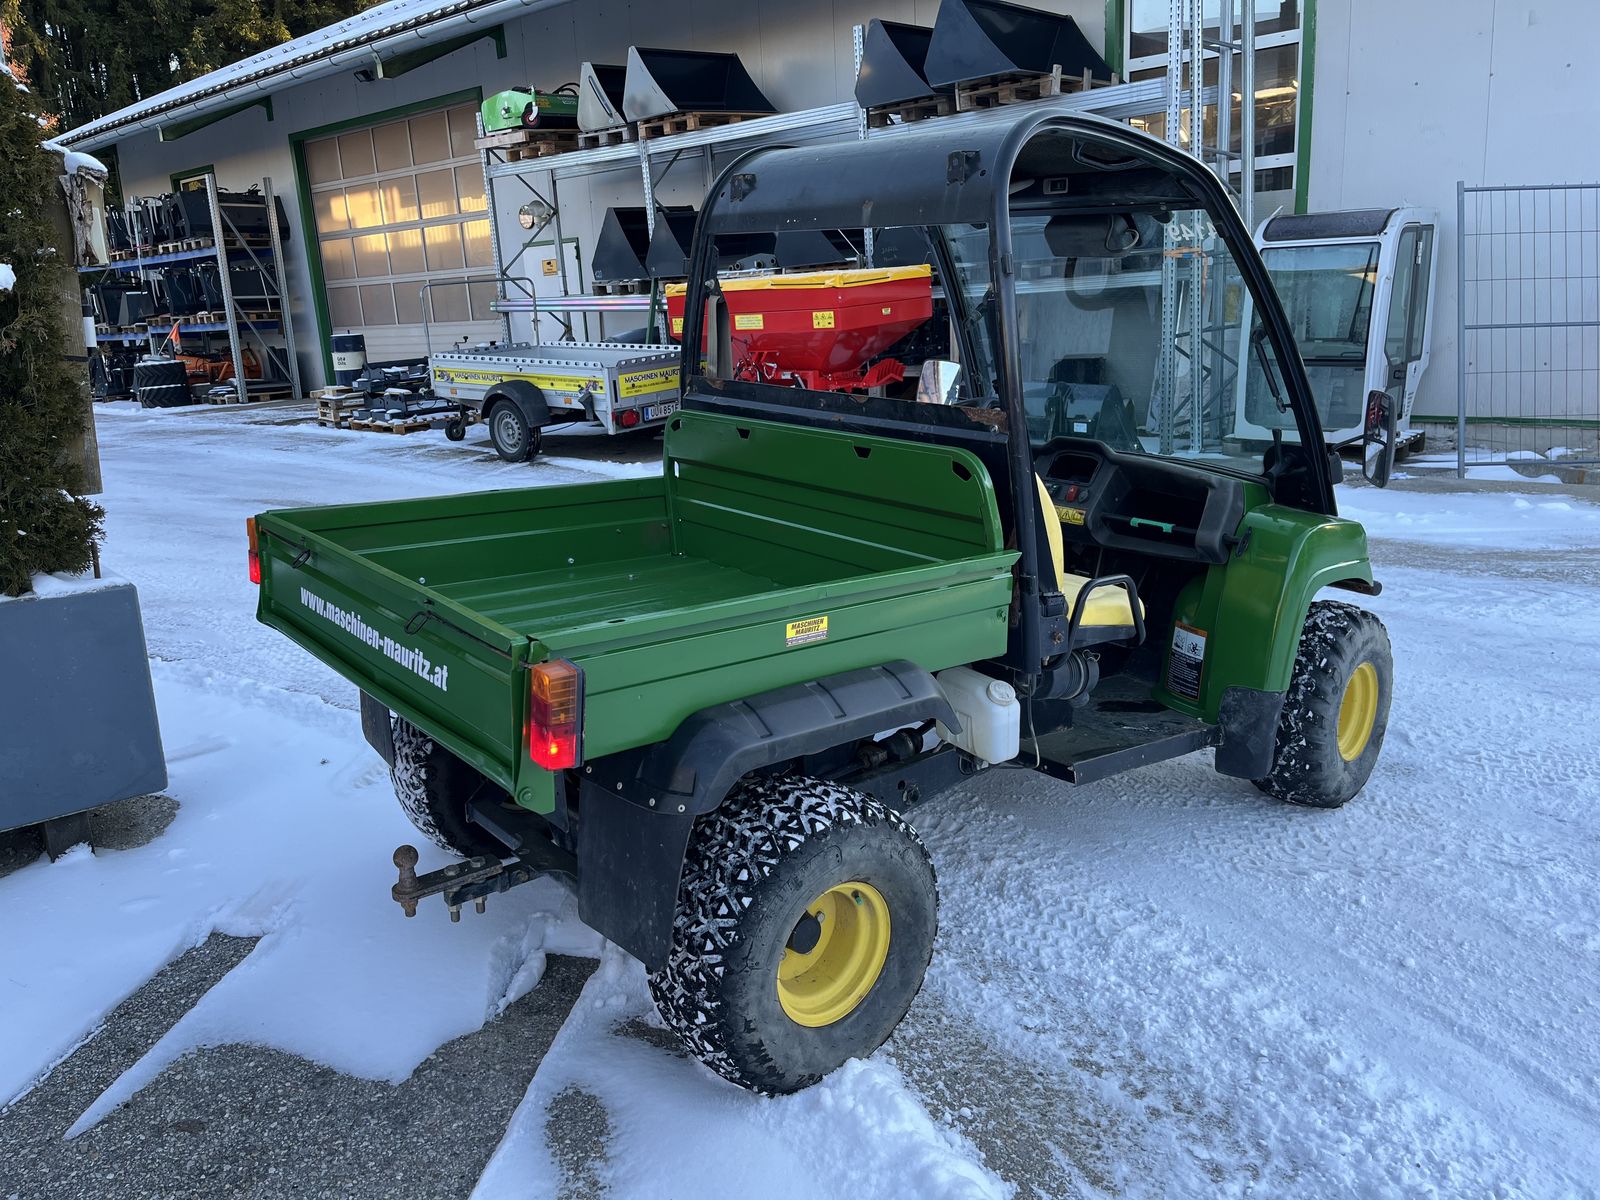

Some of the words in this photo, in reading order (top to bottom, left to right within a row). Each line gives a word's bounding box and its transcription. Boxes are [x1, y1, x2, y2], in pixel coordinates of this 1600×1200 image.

[455, 372, 480, 380] MASCHINEN
[624, 373, 658, 383] MASCHINEN
[659, 369, 680, 378] MAURIT
[791, 618, 824, 630] MASCHINEN
[795, 625, 820, 635] MAURITZ
[300, 586, 449, 692] www.maschinen-mauritz.at
